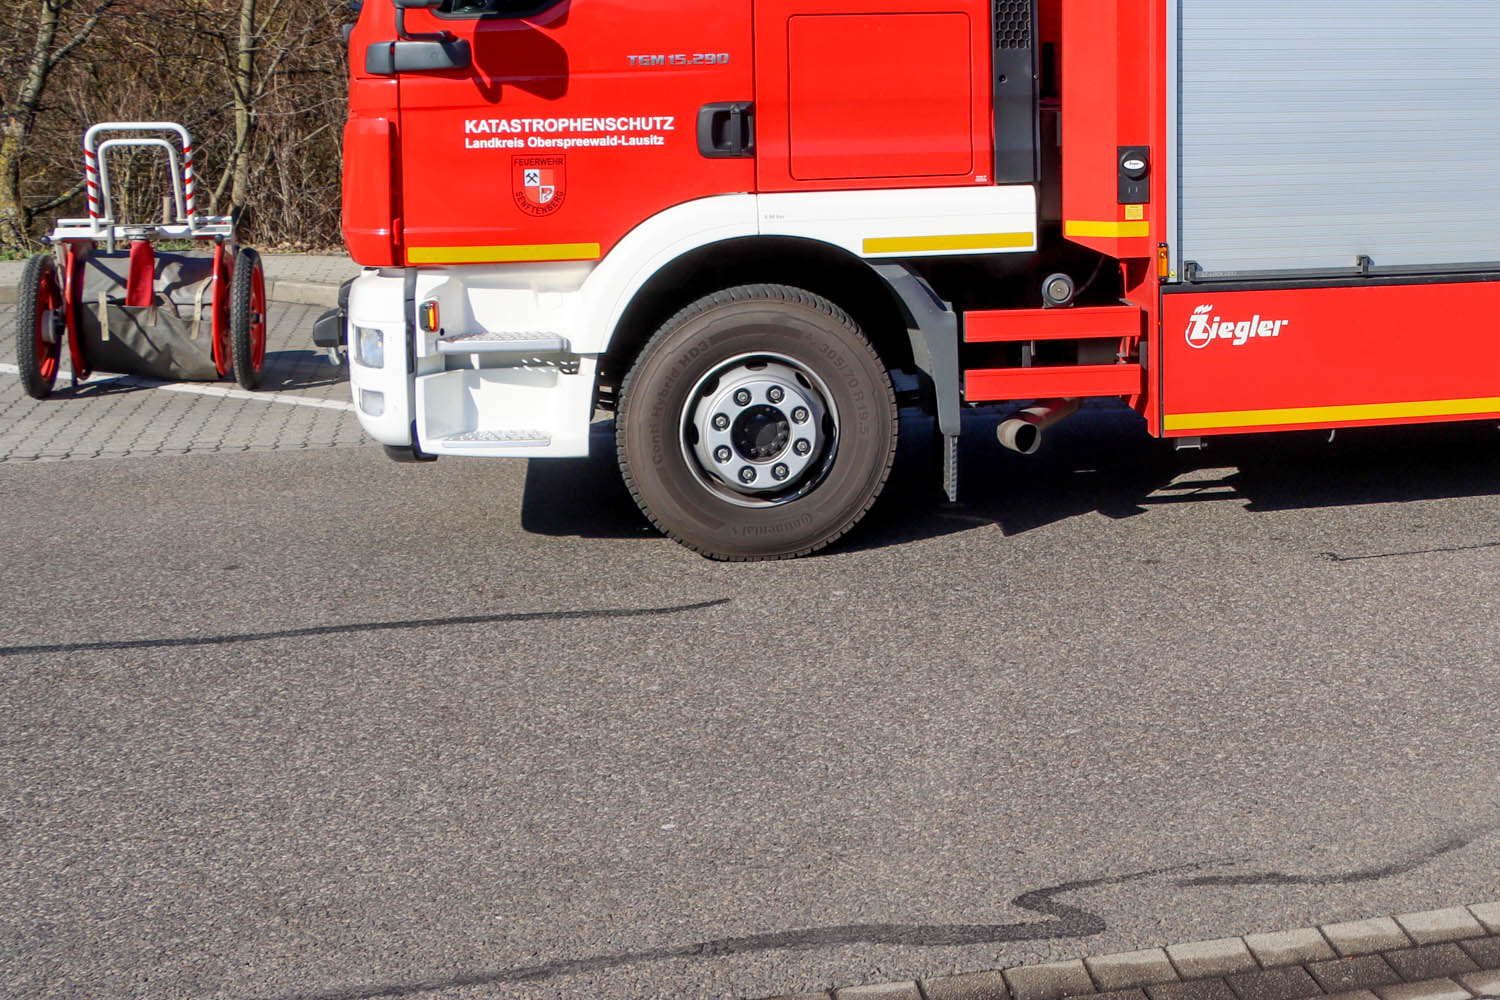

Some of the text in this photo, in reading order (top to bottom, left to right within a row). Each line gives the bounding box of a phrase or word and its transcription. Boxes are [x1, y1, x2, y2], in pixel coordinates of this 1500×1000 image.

[627, 53, 729, 66] TGM 15.290
[465, 116, 675, 134] KATASTROPHENSCHUTZ
[465, 135, 664, 149] Landkreis Oberspreewald-Lausitz
[513, 157, 564, 167] FEUERWEHR
[515, 190, 564, 215] SENFTENBERG
[1185, 309, 1289, 348] Ziegler
